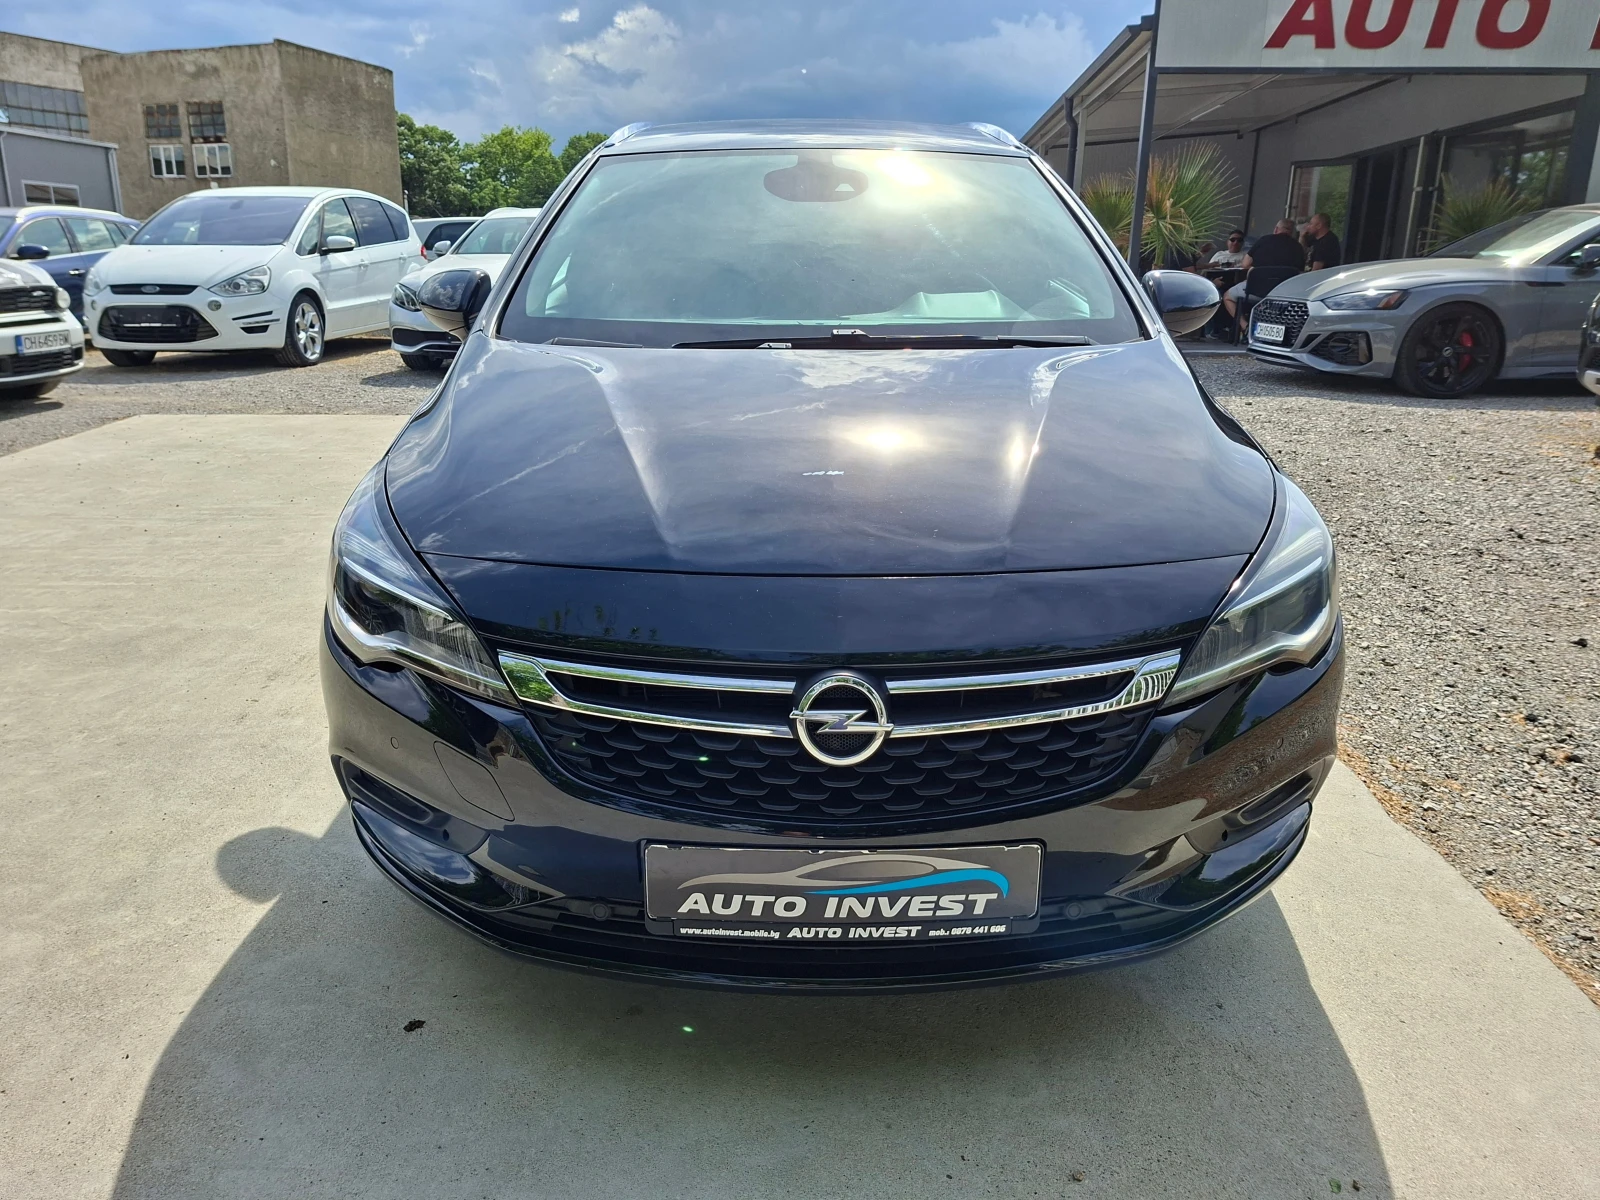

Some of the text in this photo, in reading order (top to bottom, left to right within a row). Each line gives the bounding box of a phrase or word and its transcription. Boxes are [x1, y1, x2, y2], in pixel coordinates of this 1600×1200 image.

[1263, 0, 1551, 49] AUTO
[676, 892, 998, 919] AUTO INVEST
[786, 926, 842, 938] AUTO
[848, 925, 922, 938] INVEST
[973, 925, 989, 934] 441
